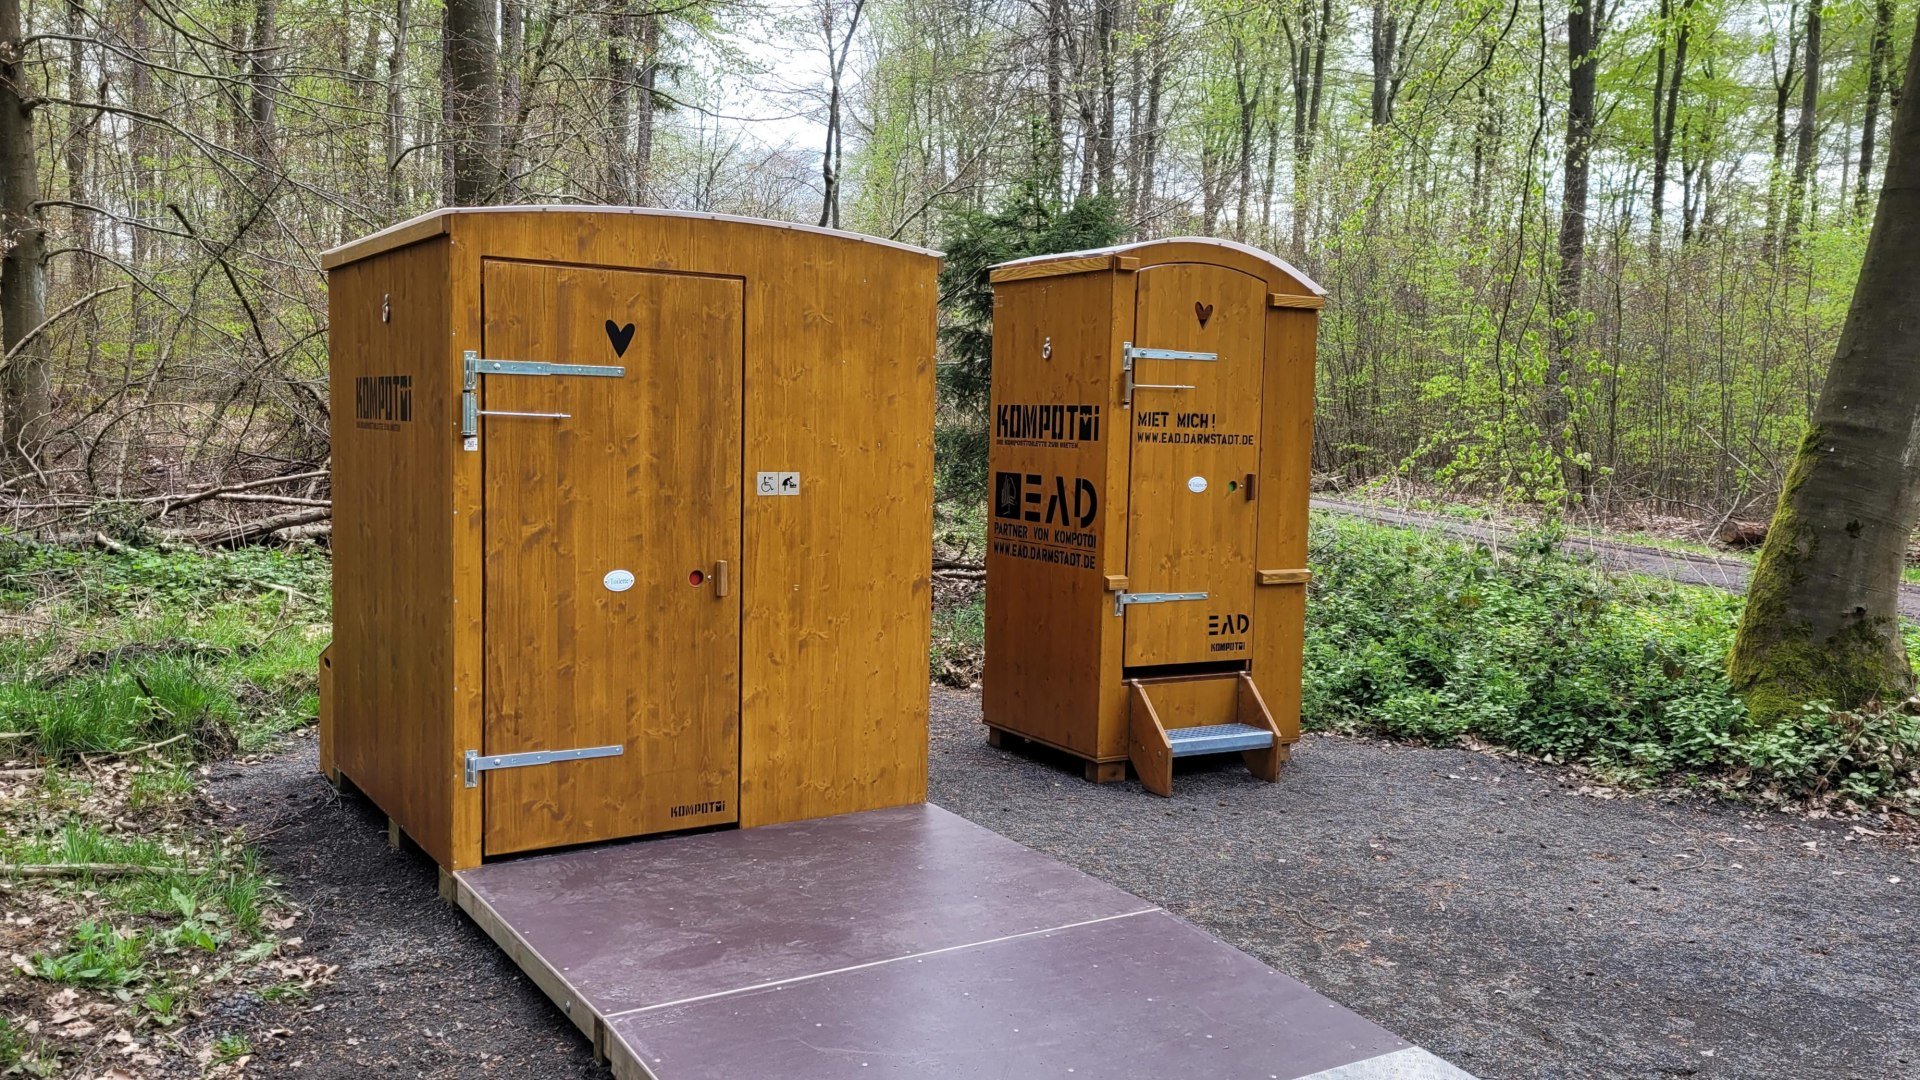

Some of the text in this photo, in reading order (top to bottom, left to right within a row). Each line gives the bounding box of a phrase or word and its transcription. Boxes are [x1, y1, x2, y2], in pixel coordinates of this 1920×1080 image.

[1138, 412, 1169, 427] MIET
[1138, 432, 1254, 445] WWW.EAD.DARMSTADT.DE
[1025, 474, 1098, 528] EAD
[994, 522, 1096, 549] PARTNER VON KOMPOTOI
[993, 540, 1096, 570] WWW.EAD.DARMSTADT.DE
[1208, 614, 1250, 636] EAD
